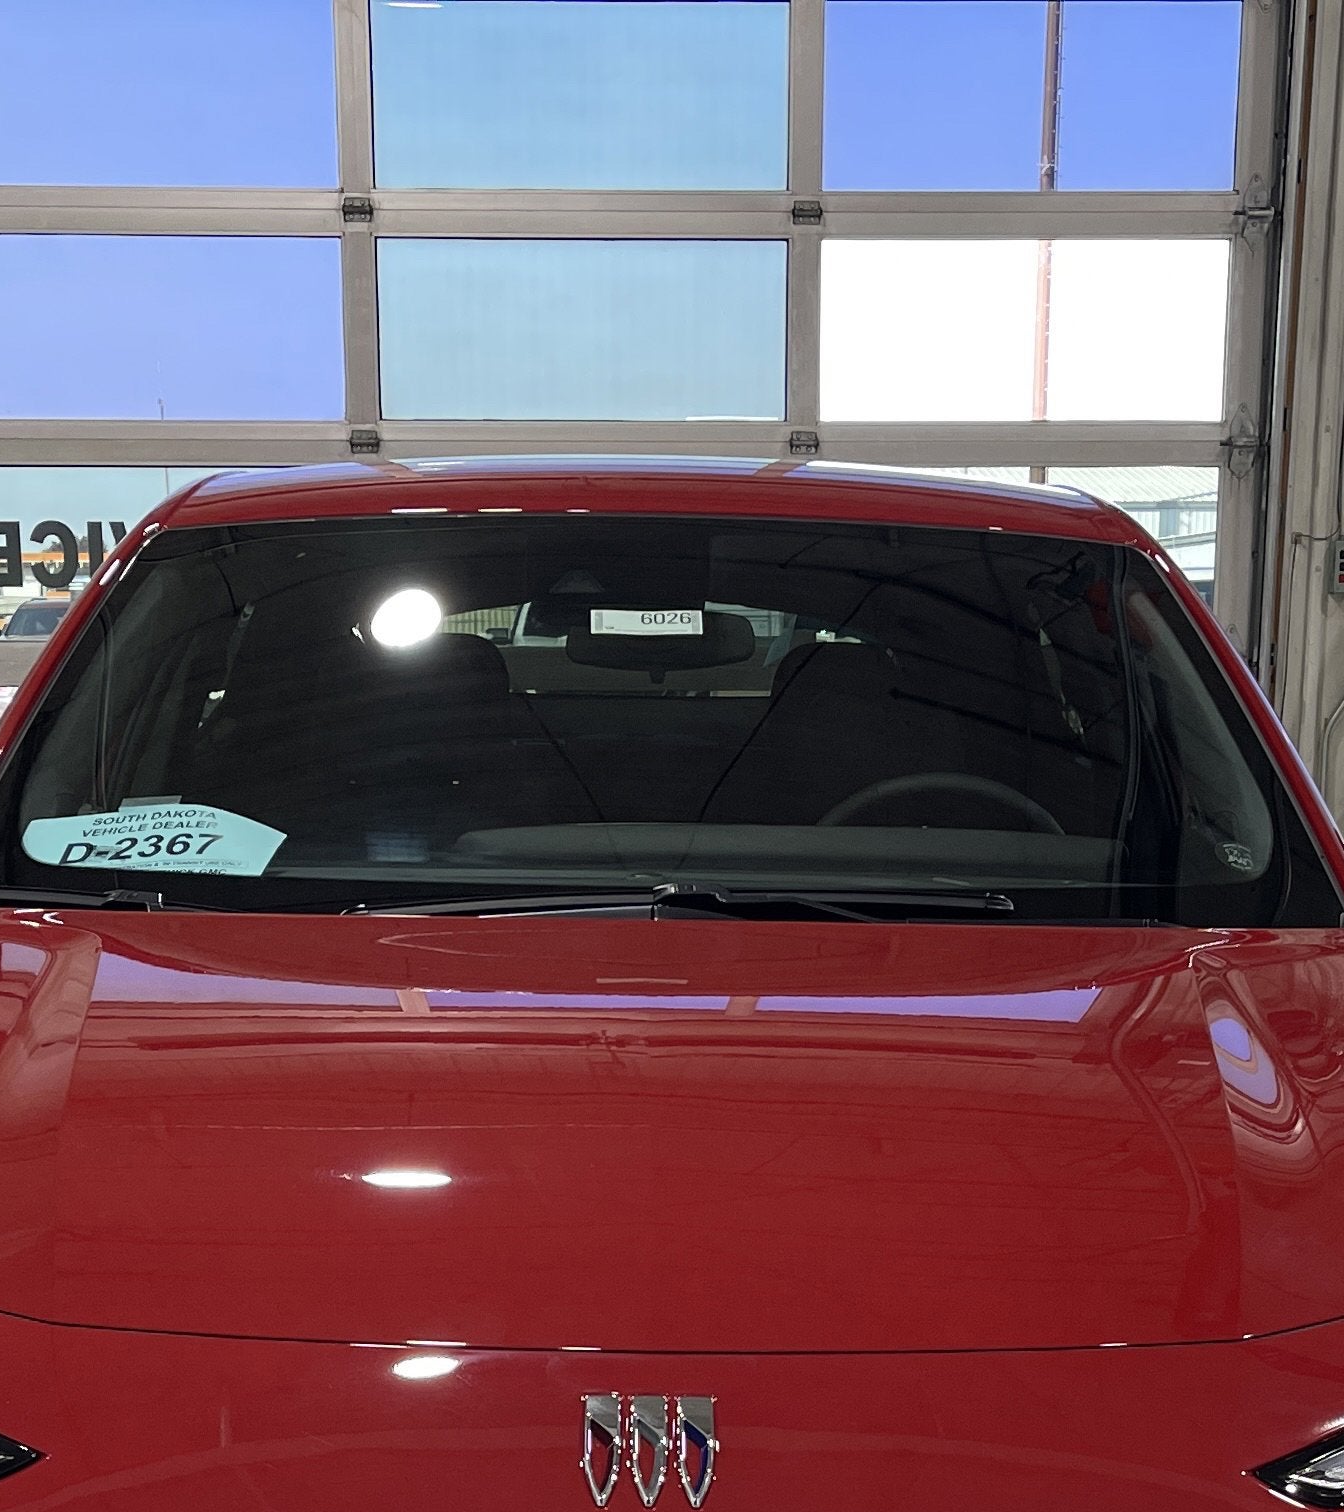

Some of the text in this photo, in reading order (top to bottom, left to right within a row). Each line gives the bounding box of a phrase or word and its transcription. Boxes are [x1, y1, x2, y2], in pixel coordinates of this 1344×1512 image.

[640, 612, 692, 625] 6026
[92, 809, 217, 826] SOUTH DAKOTA
[82, 820, 218, 838] VEHICLE DEALER
[58, 833, 224, 865] D-2367
